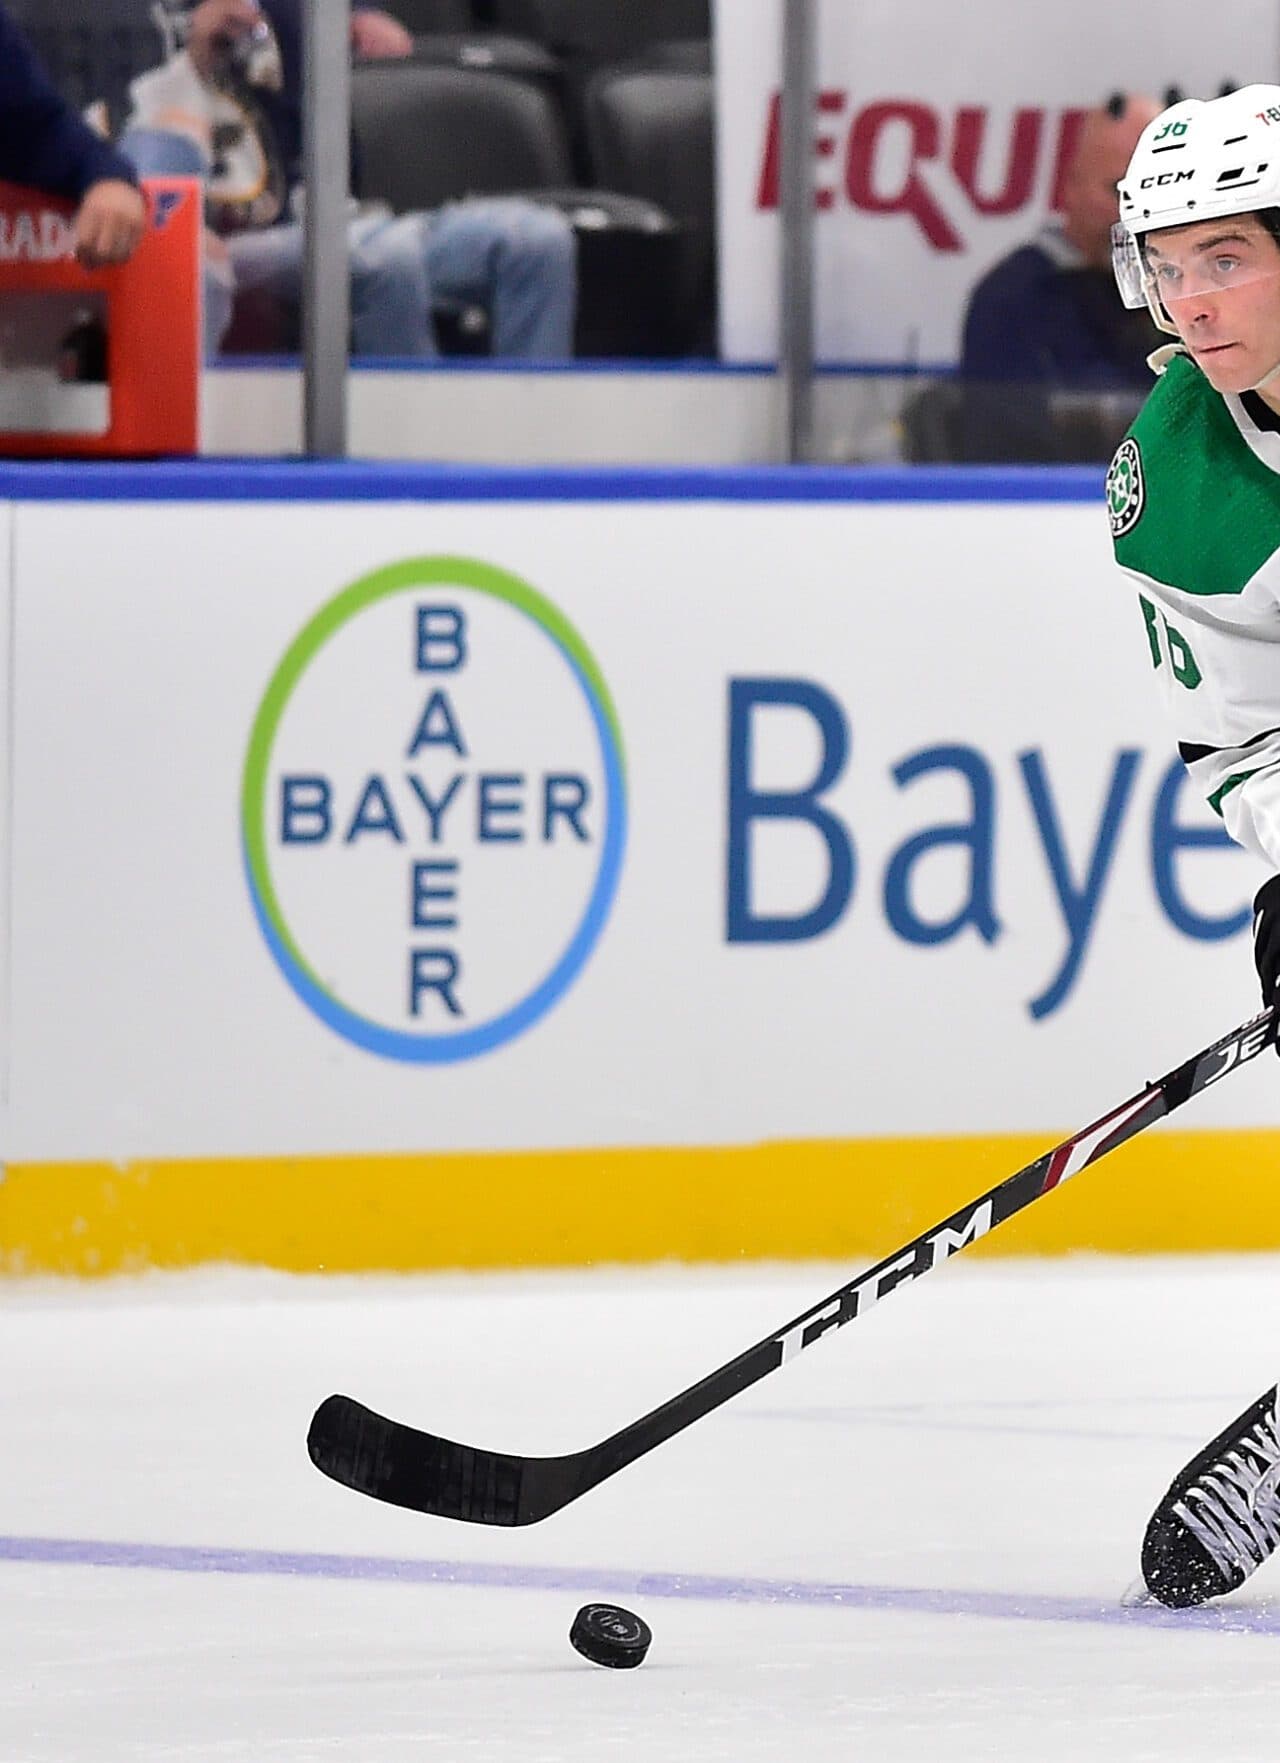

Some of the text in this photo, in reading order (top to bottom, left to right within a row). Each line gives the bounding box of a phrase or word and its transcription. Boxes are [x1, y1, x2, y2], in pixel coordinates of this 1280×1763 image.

[1140, 169, 1195, 190] CCM
[279, 771, 592, 846] BAYER
[406, 602, 468, 1019] BAYER
[723, 672, 1253, 1023] Baye
[774, 1198, 993, 1369] CCM
